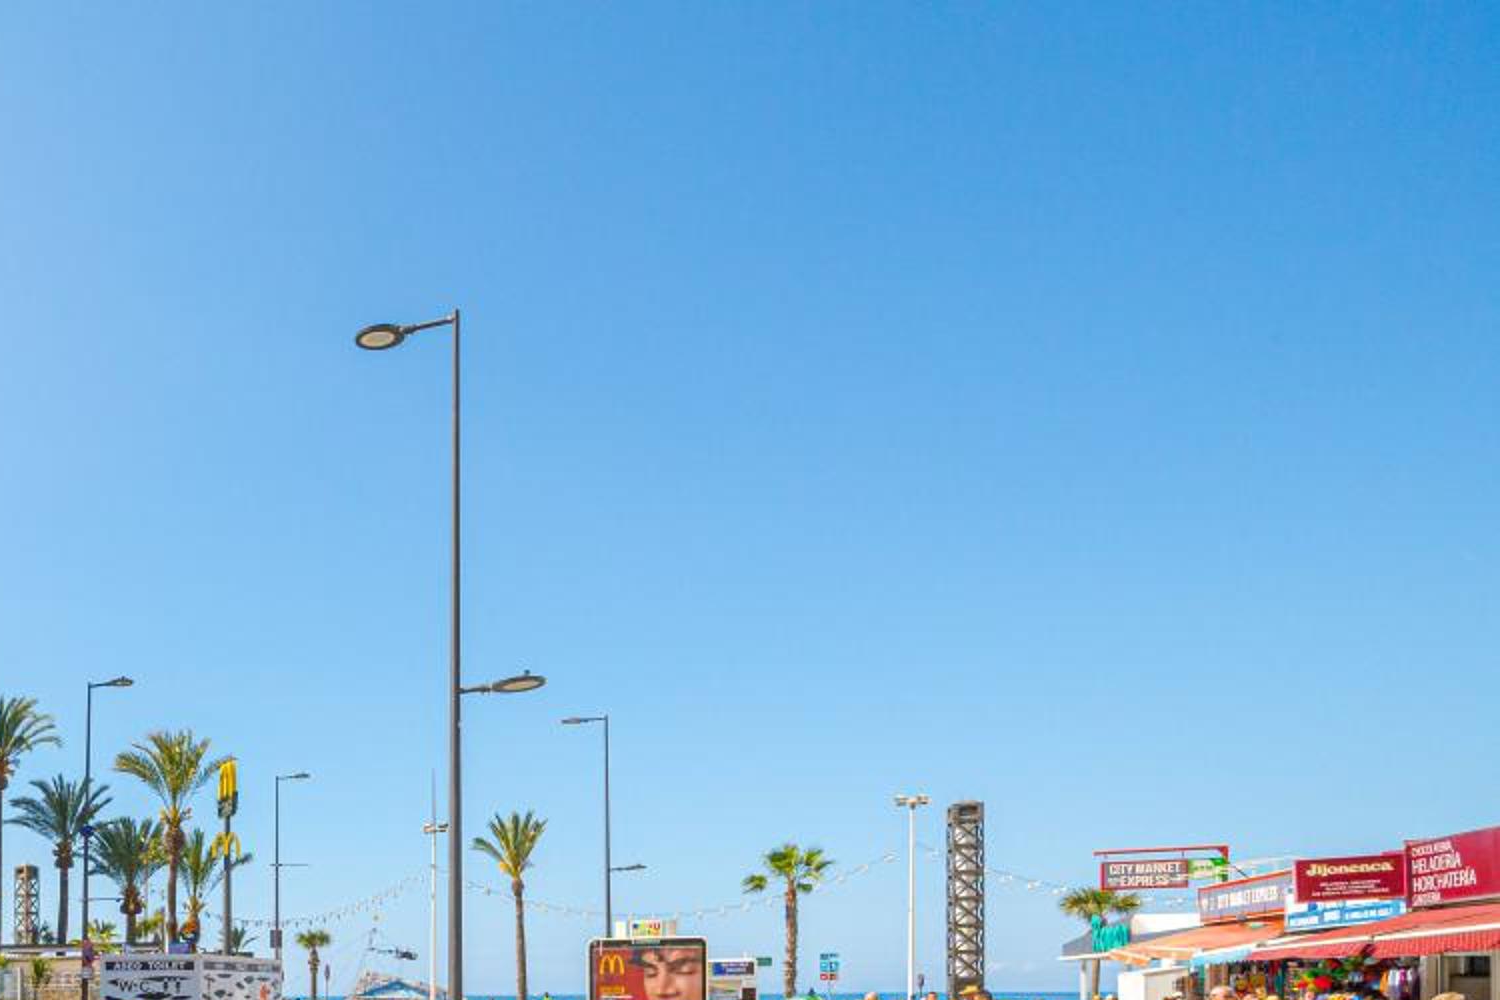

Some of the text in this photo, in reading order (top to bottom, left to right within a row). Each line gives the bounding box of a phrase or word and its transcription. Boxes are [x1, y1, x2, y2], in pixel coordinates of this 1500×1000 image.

[1109, 863, 1132, 874] CITY
[1135, 862, 1181, 873] MARKET
[1306, 862, 1395, 877] Jijonenca
[1120, 875, 1170, 887] EXPRESS
